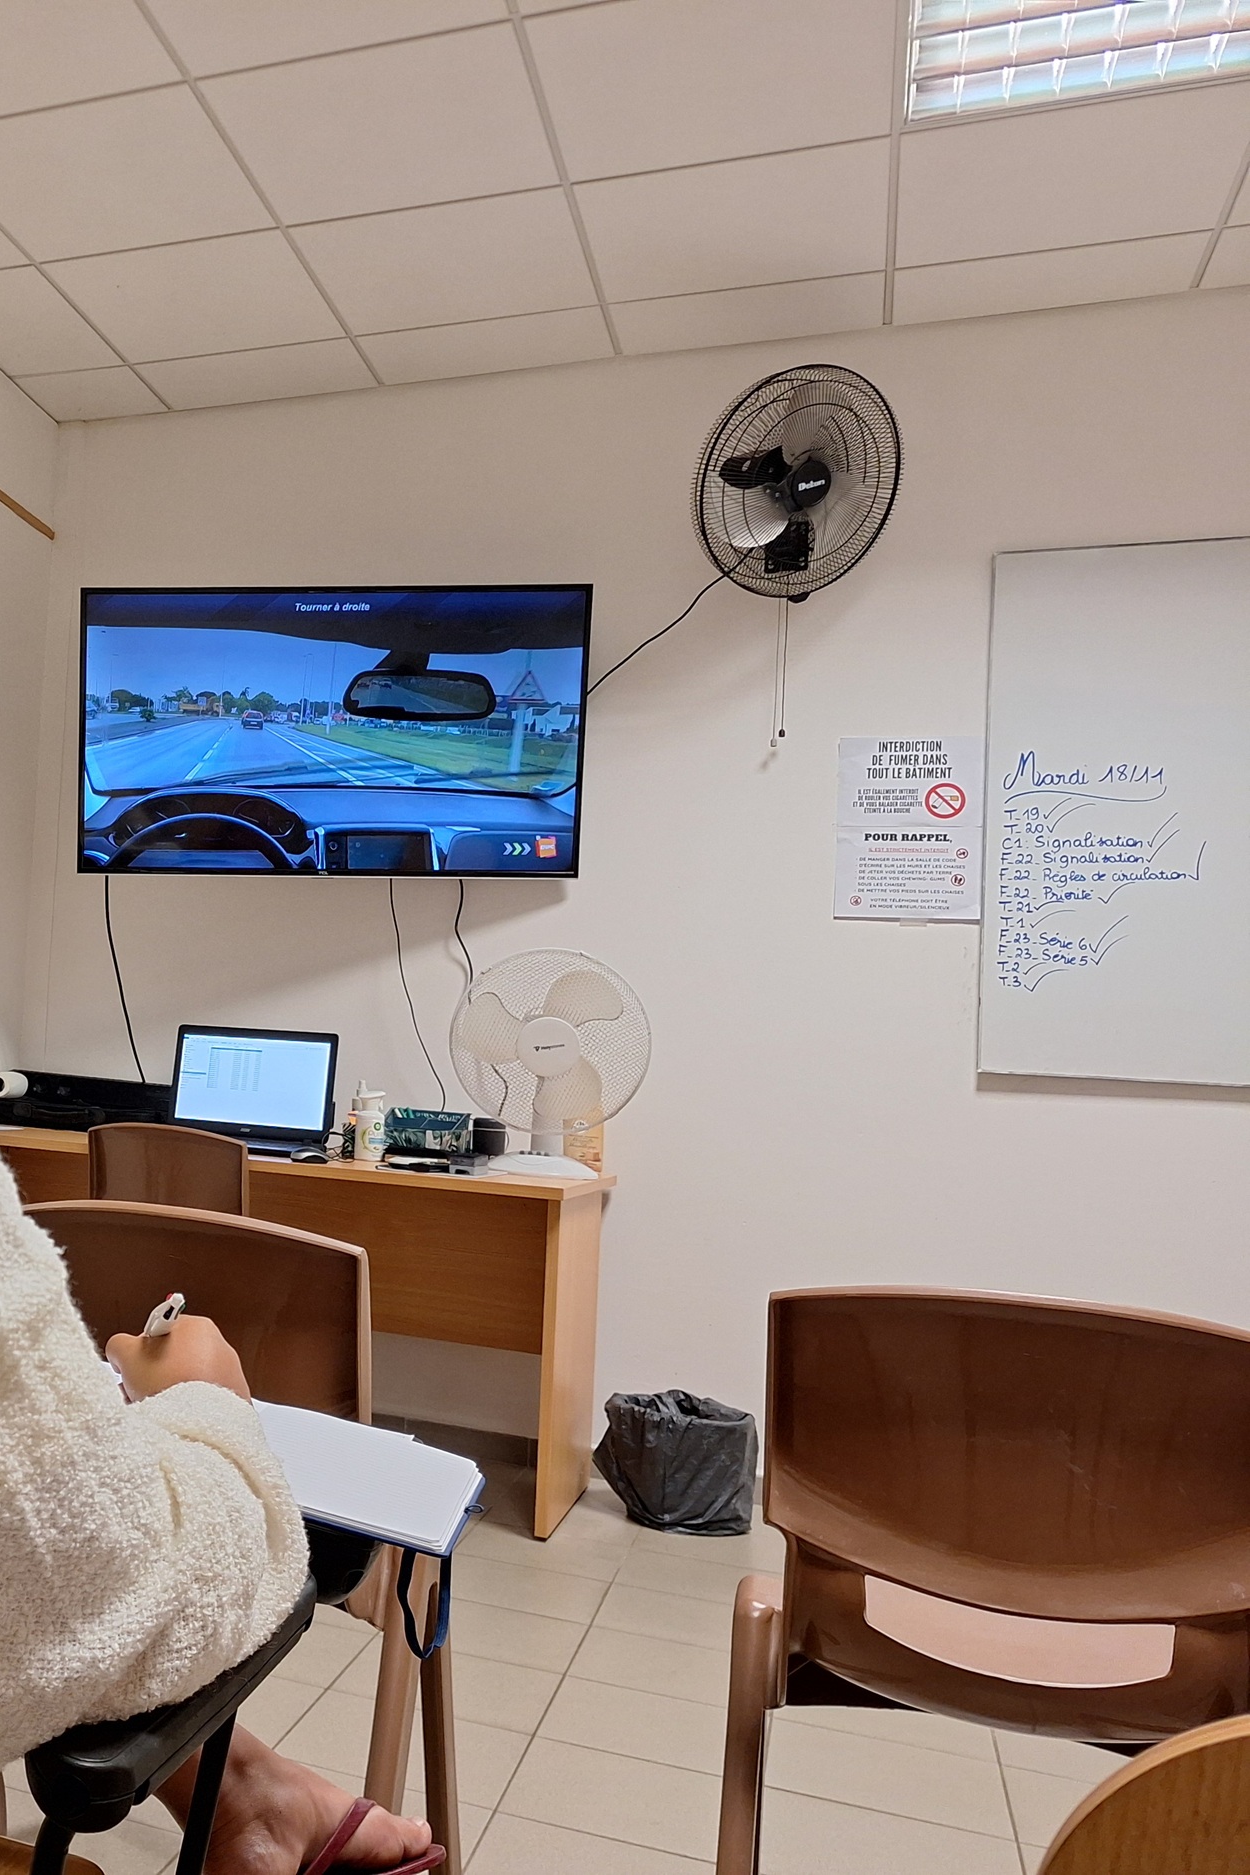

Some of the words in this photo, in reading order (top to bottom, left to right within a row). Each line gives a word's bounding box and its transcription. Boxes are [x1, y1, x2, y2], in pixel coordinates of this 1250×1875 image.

[295, 602, 332, 611] Tourner
[334, 602, 340, 611] à
[342, 602, 370, 611] droite
[879, 741, 942, 752] INTERDICTION
[872, 755, 883, 765] DE
[889, 754, 919, 765] FUMER
[923, 754, 948, 765] DANS
[867, 768, 889, 779] TOUT
[892, 768, 902, 778] LE
[905, 764, 952, 778] BÂTIMENT
[1003, 750, 1089, 790] Mardi
[1098, 763, 1164, 785] 18/11
[864, 833, 897, 841] POUR
[901, 834, 952, 843] RAPPEL,
[1034, 831, 1143, 854] Signalisation
[1042, 851, 1144, 869] Signalisation
[1091, 871, 1106, 882] de
[1112, 866, 1187, 882] circulation
[1042, 886, 1094, 901] Priorité
[1038, 931, 1073, 950] Série
[1078, 937, 1088, 951] 6
[1041, 948, 1076, 965] Série
[1078, 955, 1089, 967] 5
